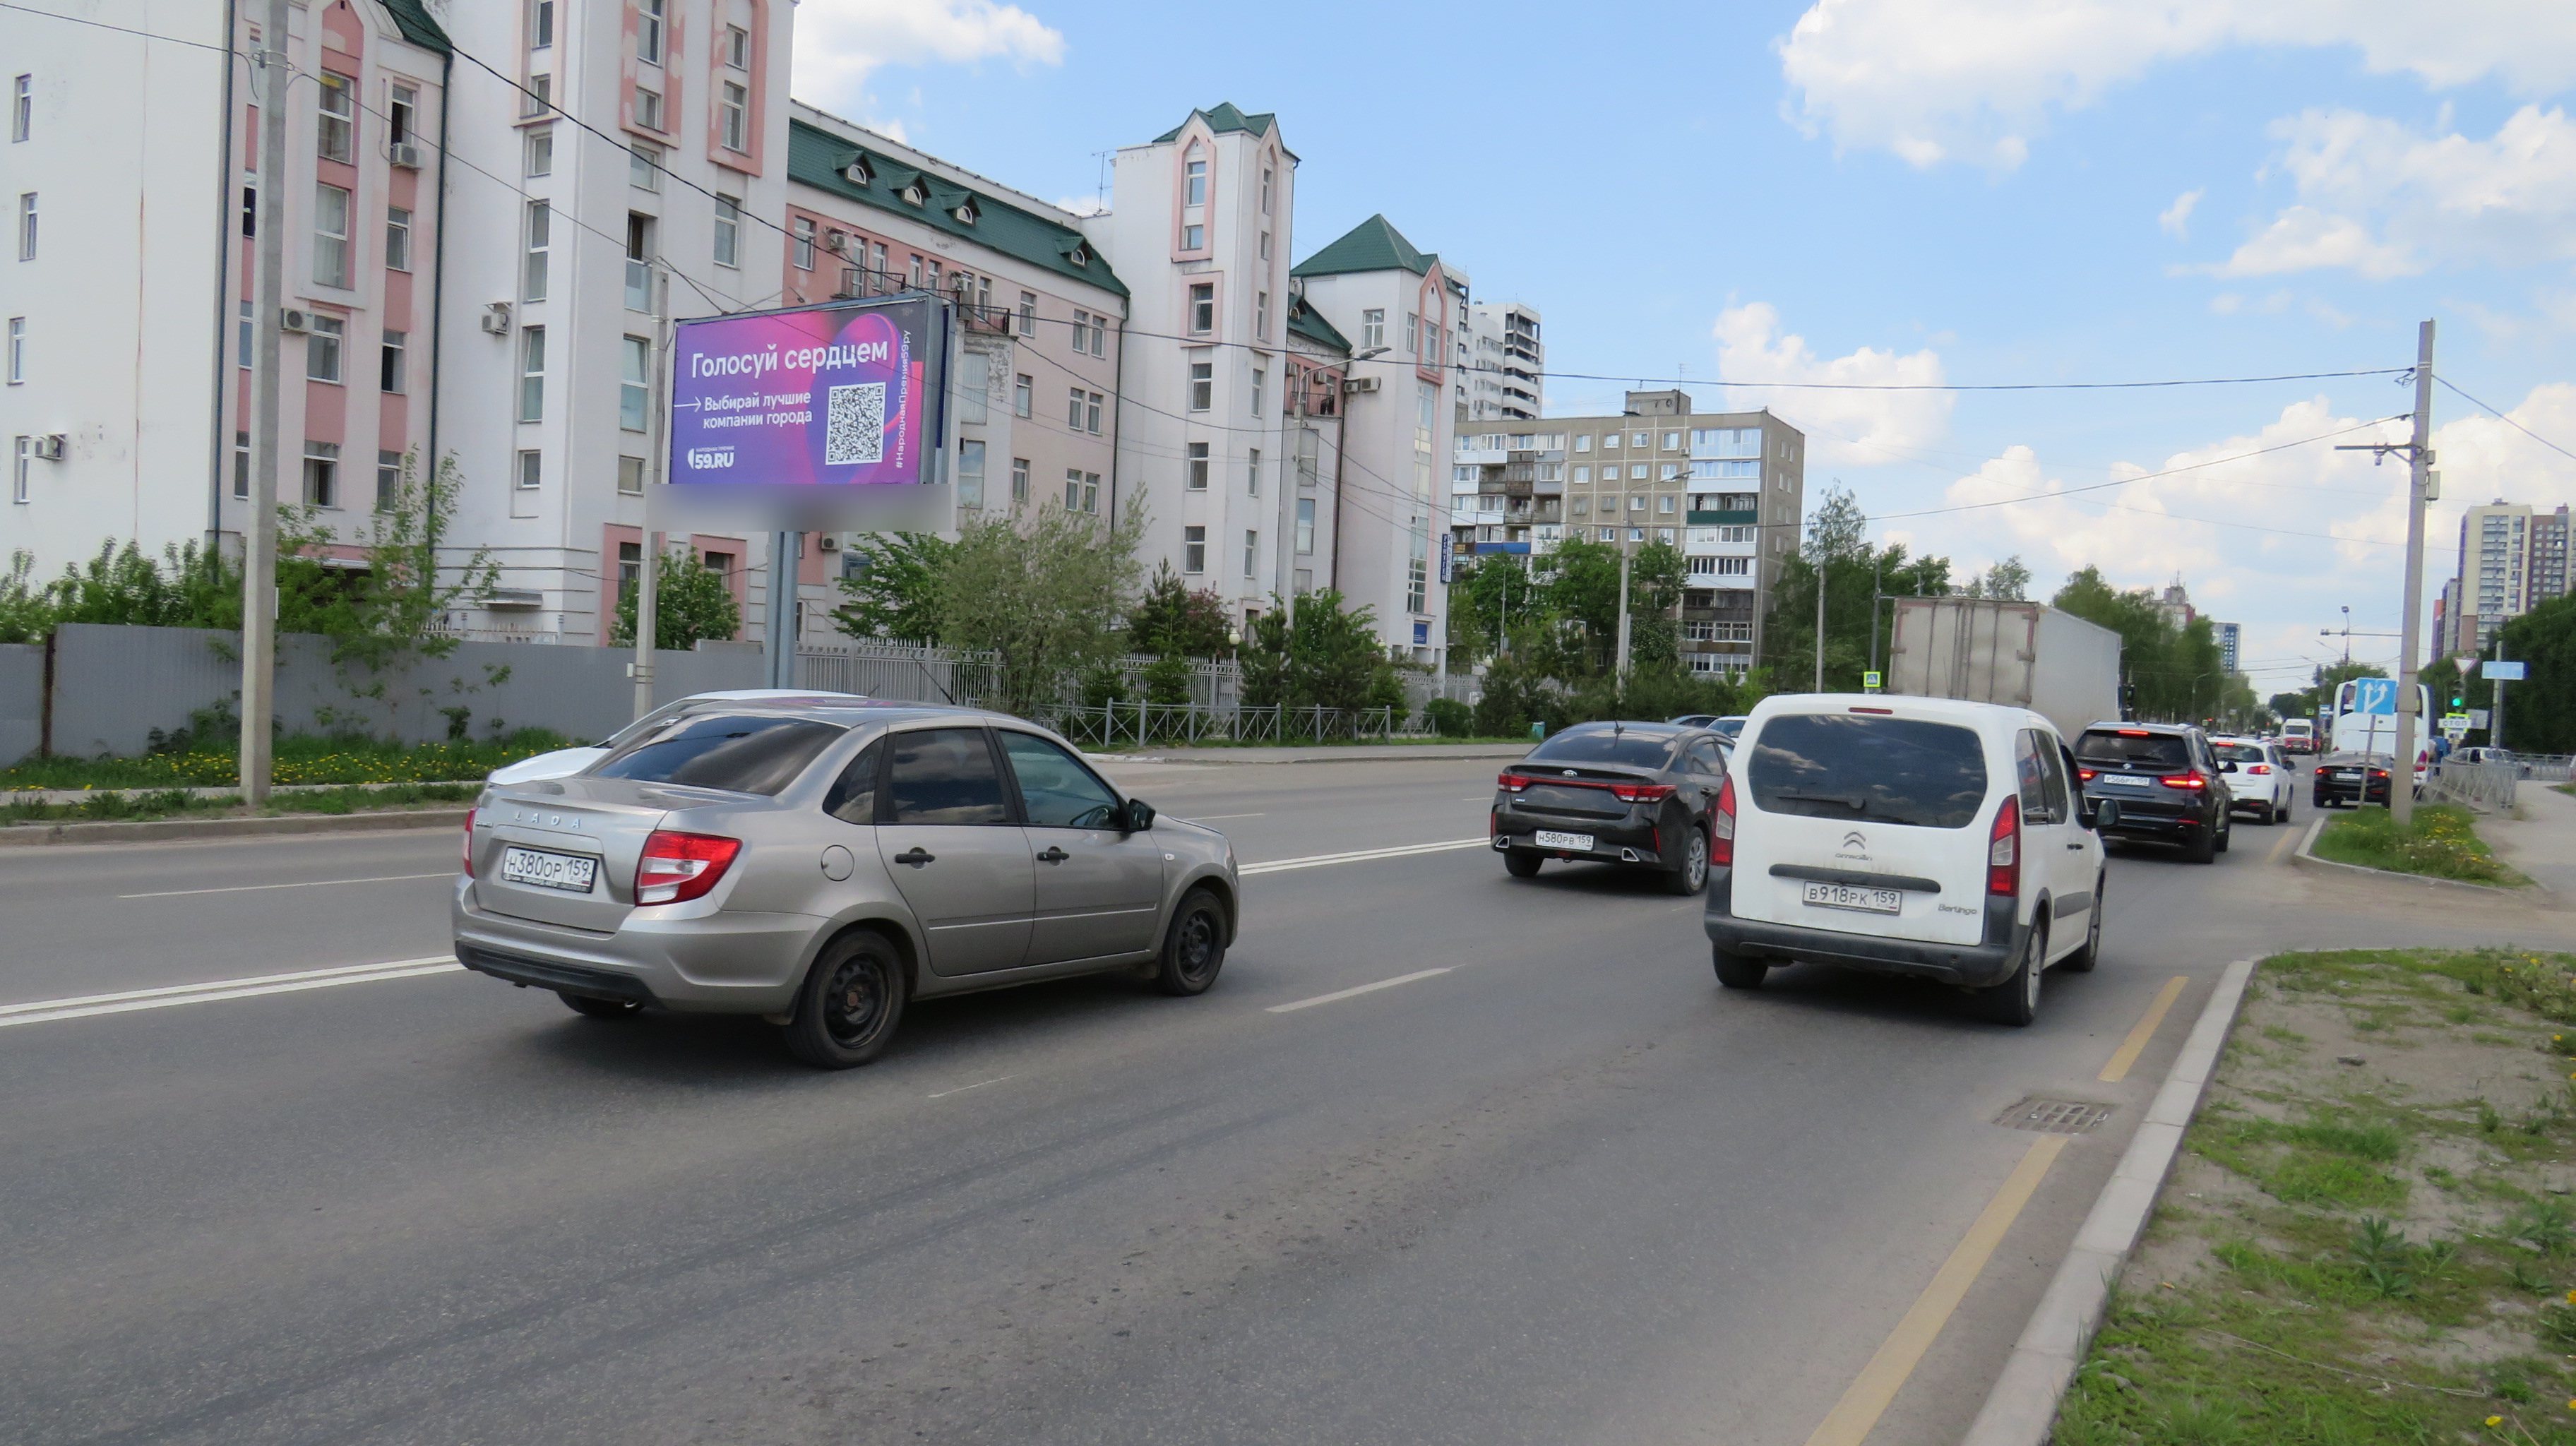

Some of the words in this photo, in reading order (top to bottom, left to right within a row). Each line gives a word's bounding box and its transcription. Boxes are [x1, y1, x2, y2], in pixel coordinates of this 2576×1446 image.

[692, 343, 777, 378] Голосуй
[785, 341, 888, 374] сердцем
[704, 392, 760, 412] Выбирай
[763, 392, 811, 410] лучшие
[895, 330, 912, 469] #НароднаяПремия59ру
[703, 414, 763, 429] компании
[767, 410, 813, 427] города
[694, 452, 734, 470] 59.RU
[515, 811, 580, 829] LADA
[1539, 833, 1575, 845] Н580РВ
[1578, 835, 1592, 844] 159
[508, 853, 562, 878] Н380ОР
[566, 858, 590, 877] 159
[1809, 886, 1868, 905] В918РК
[1873, 891, 1897, 904] 159
[1938, 904, 1978, 916] Berlingo
